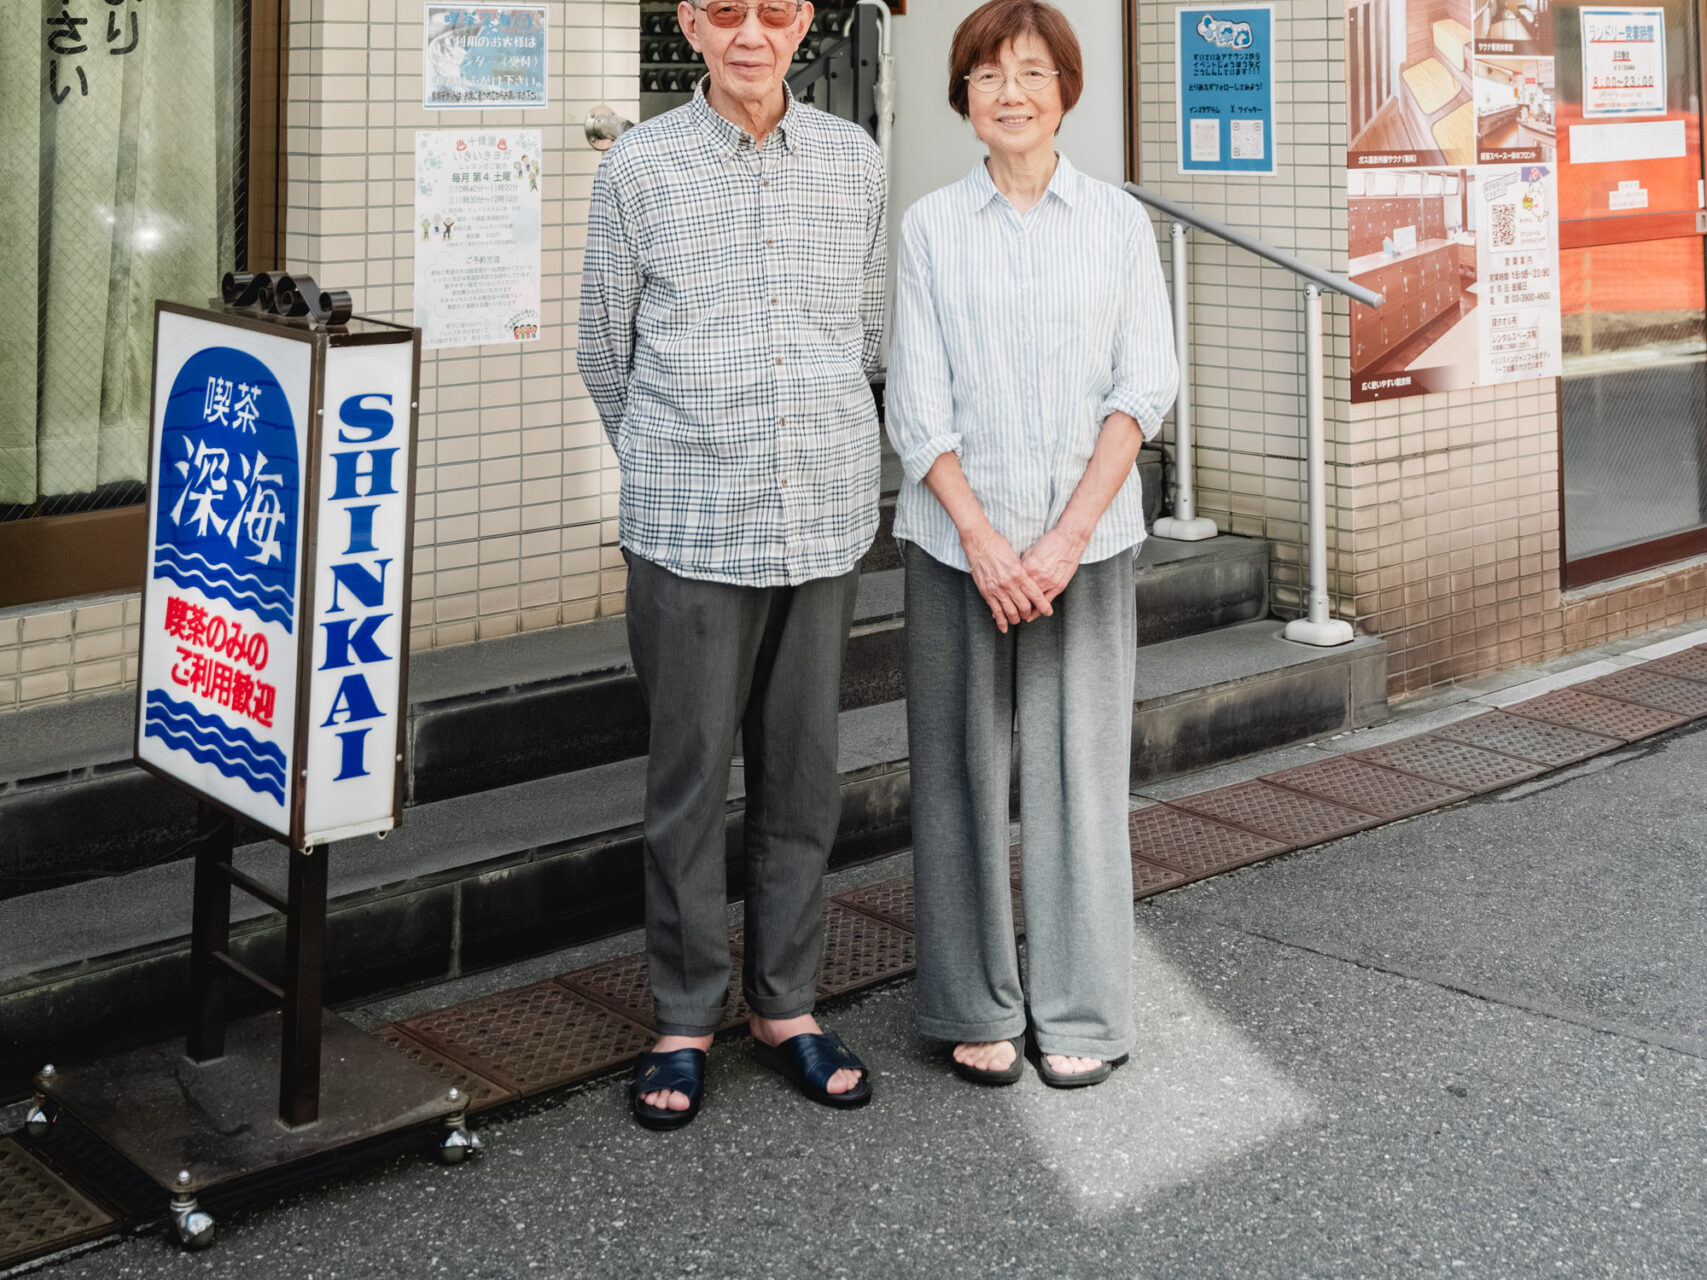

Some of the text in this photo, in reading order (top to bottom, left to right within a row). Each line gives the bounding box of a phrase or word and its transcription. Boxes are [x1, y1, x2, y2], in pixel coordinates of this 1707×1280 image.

[452, 172, 470, 183] 毎月
[493, 171, 511, 182] 土曜
[203, 375, 261, 436] 喫茶
[169, 433, 286, 566] 深海
[318, 392, 401, 782] SHINKAI
[164, 596, 269, 673] 喫茶のみの
[171, 645, 277, 730] ご利用歓迎
